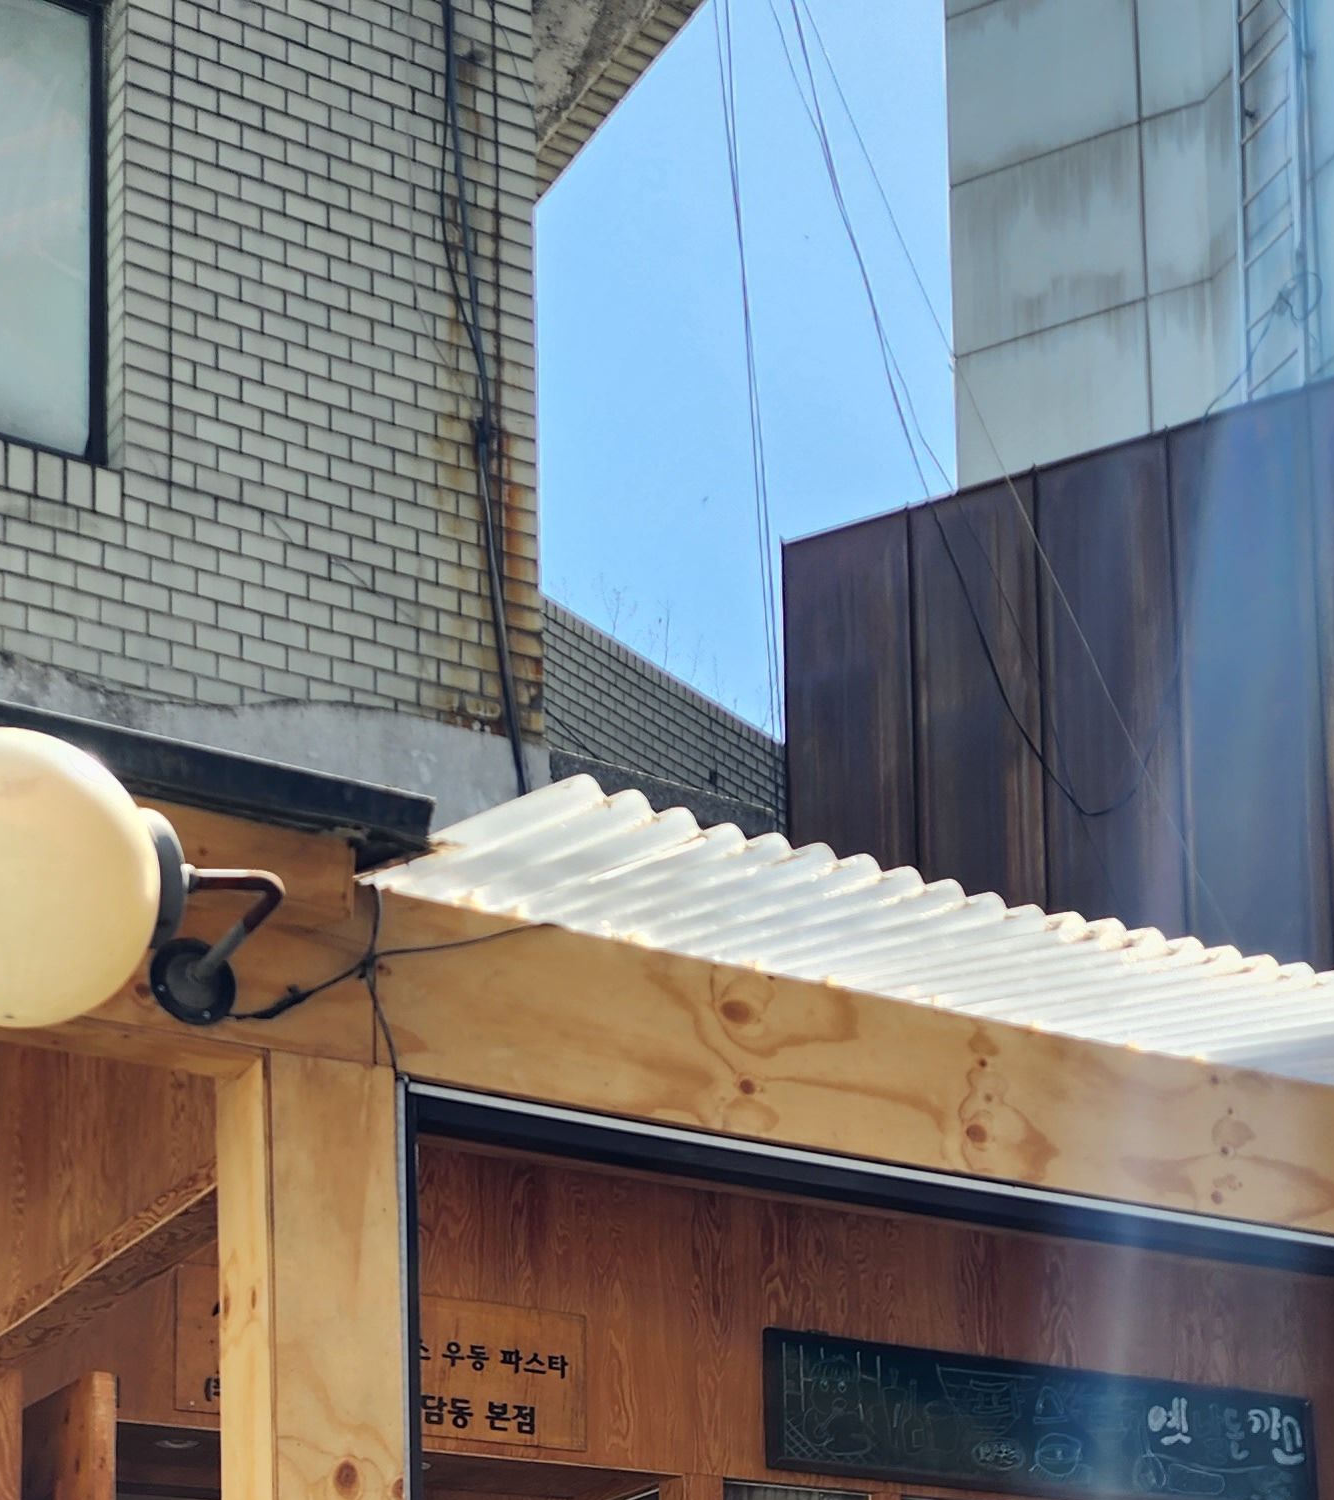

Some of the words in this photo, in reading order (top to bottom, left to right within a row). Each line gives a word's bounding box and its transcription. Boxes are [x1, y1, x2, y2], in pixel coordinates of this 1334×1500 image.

[442, 1341, 490, 1371] 우동
[499, 1349, 569, 1379] 파스타
[485, 1401, 536, 1435] 본점
